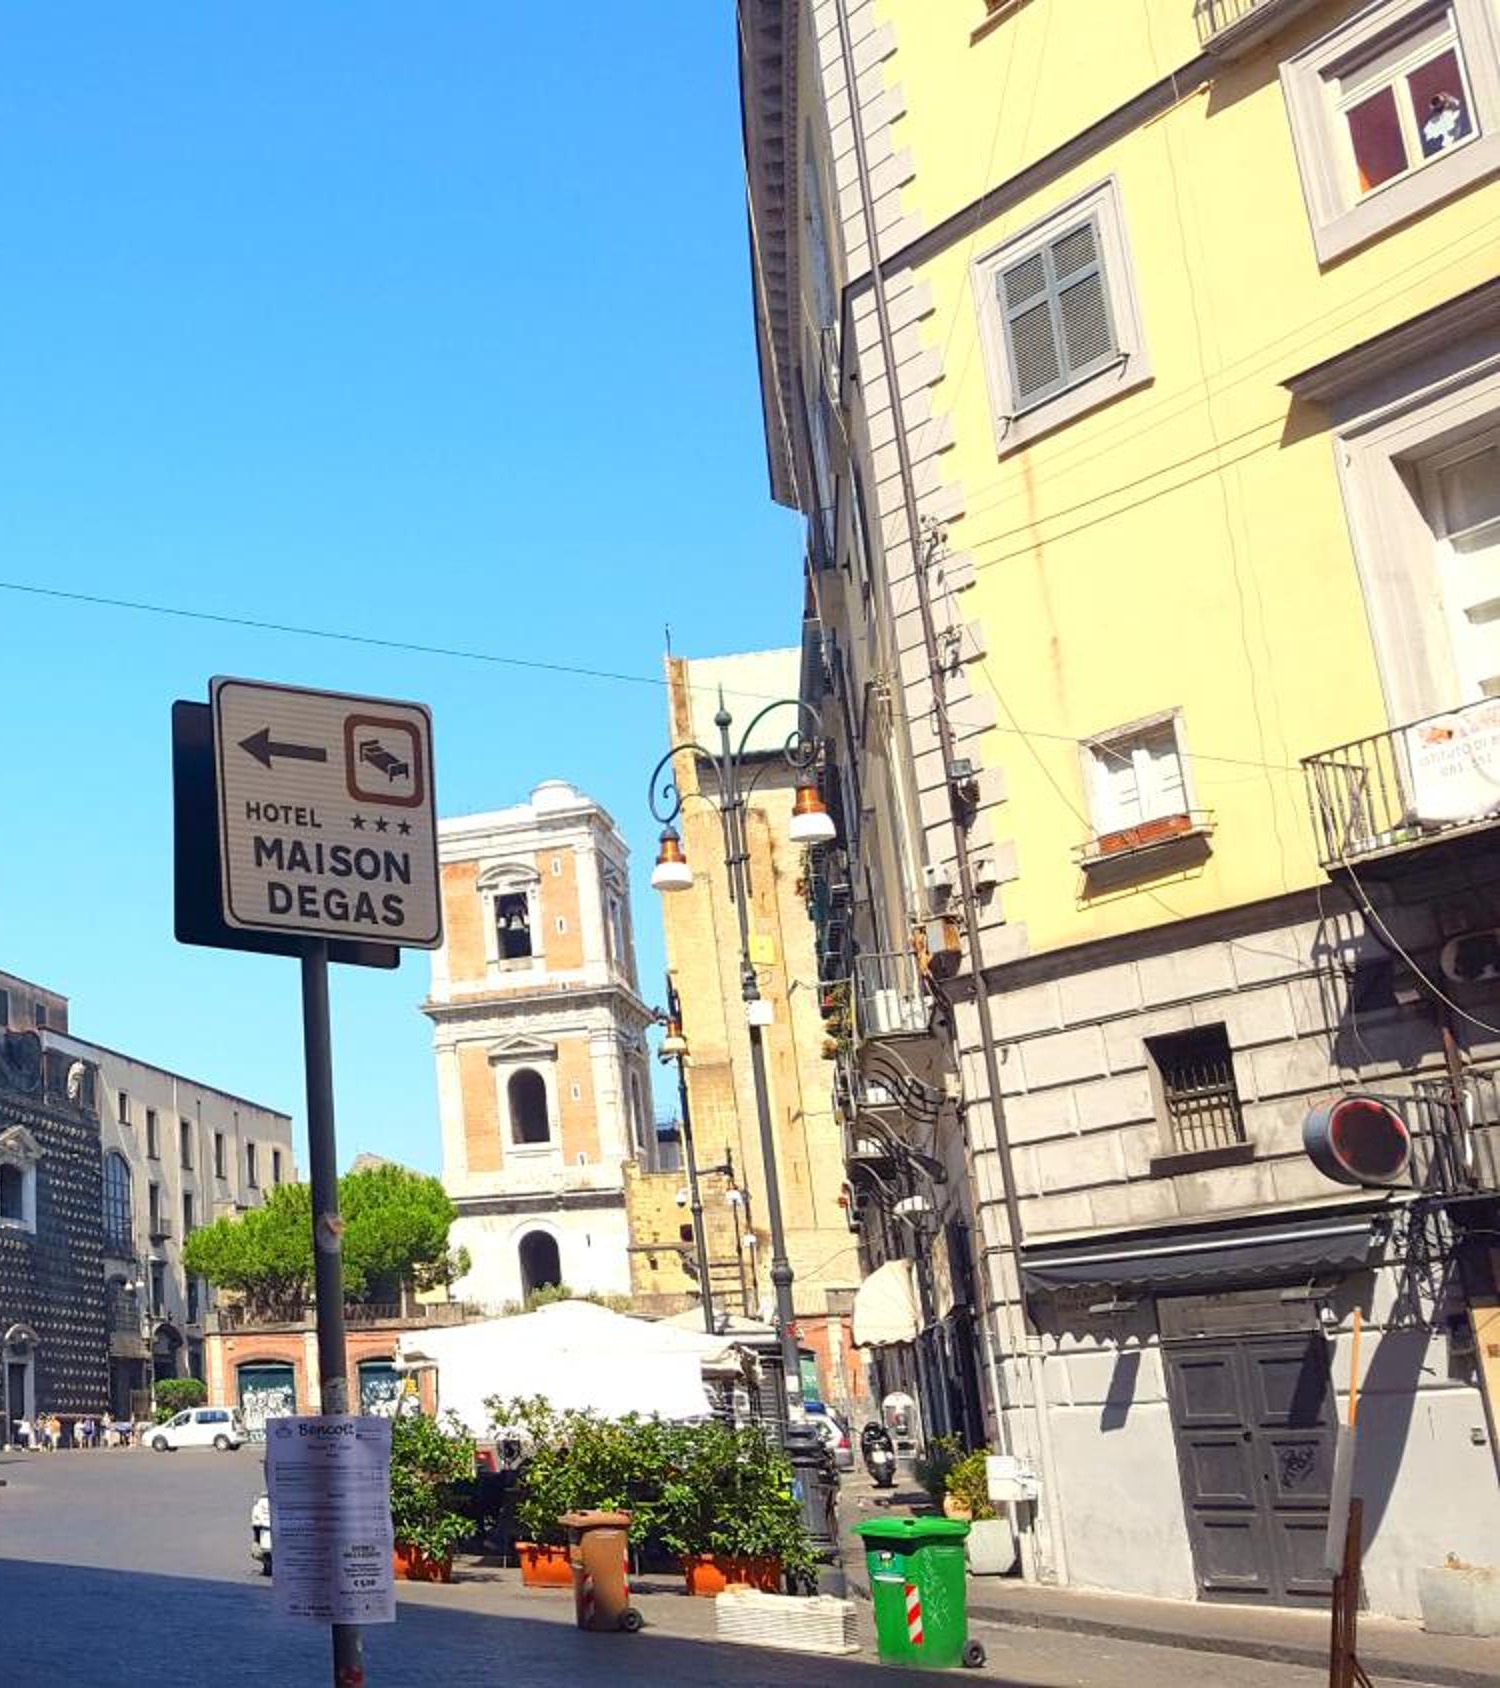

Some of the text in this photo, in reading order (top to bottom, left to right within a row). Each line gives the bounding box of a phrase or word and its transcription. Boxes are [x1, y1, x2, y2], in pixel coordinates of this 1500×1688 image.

[246, 801, 322, 828] HOTEL
[253, 836, 411, 884] MAISON
[267, 881, 405, 927] DEGAS
